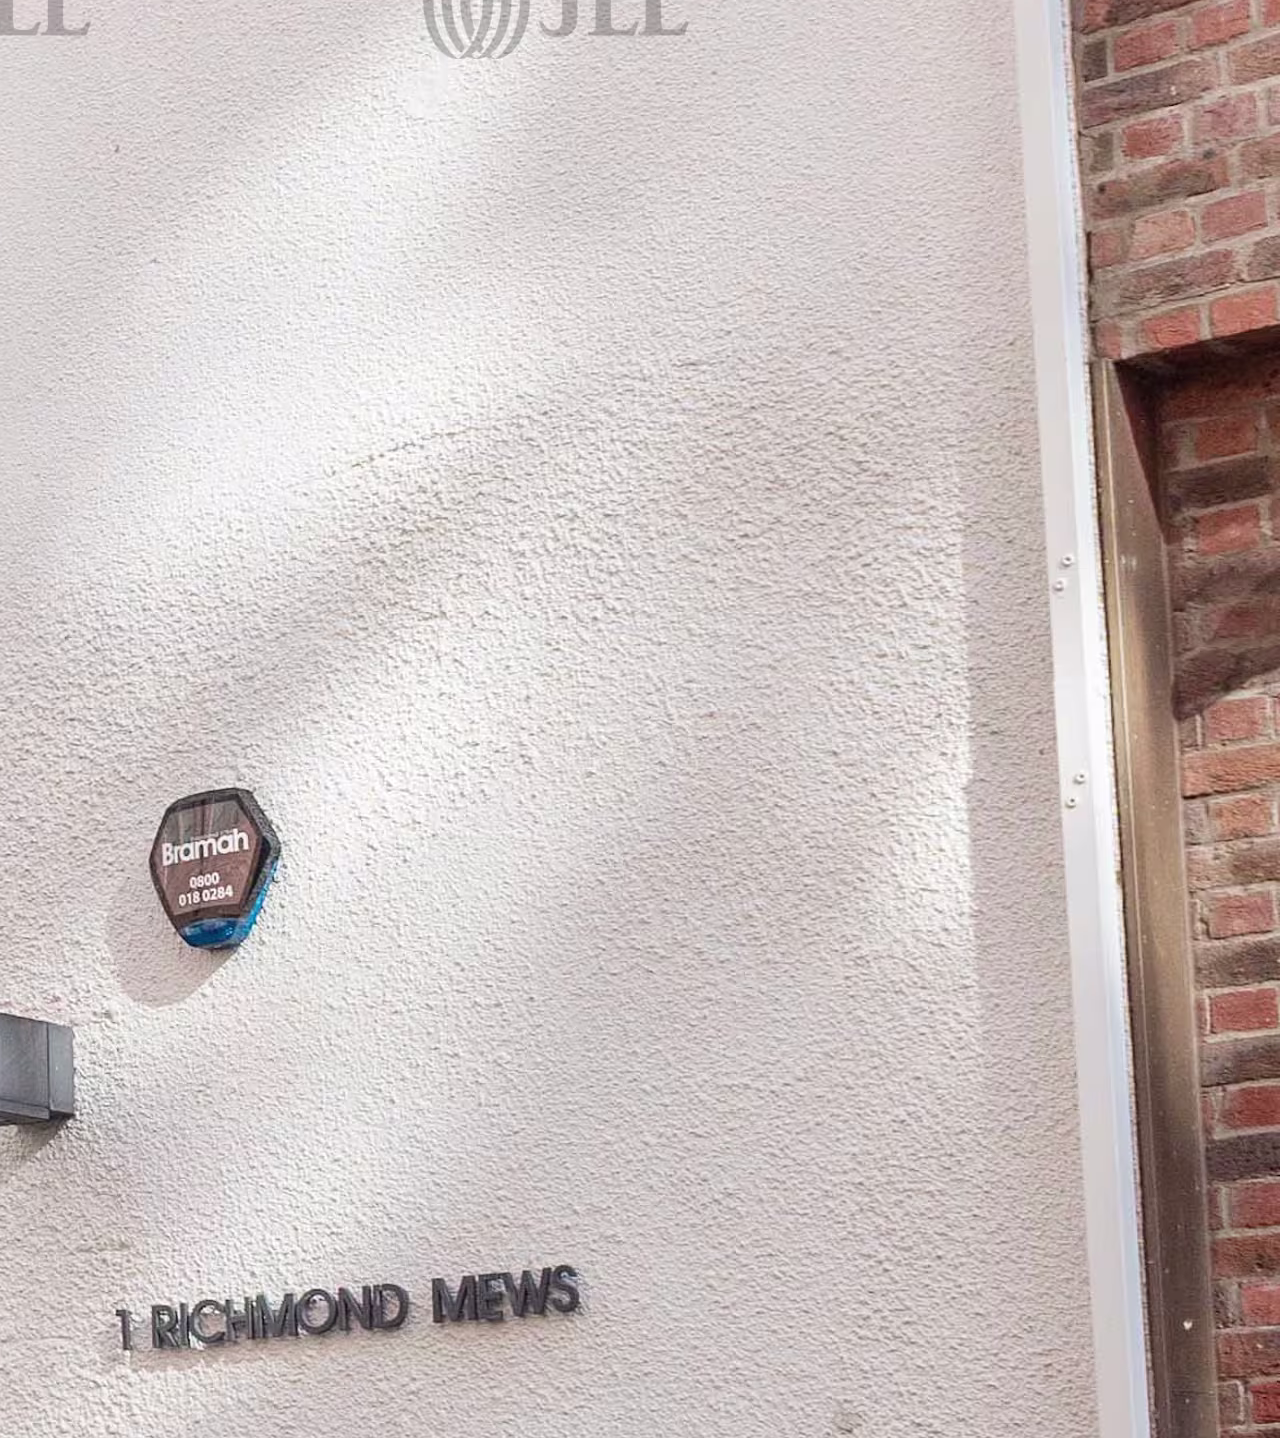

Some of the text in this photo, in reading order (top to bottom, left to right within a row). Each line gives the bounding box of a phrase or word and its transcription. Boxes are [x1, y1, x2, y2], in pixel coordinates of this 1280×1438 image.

[161, 828, 249, 866] Bramah
[189, 872, 220, 889] 0800
[178, 885, 233, 907] 018 0284
[115, 1264, 581, 1351] 1 RICHMOND MEWS
